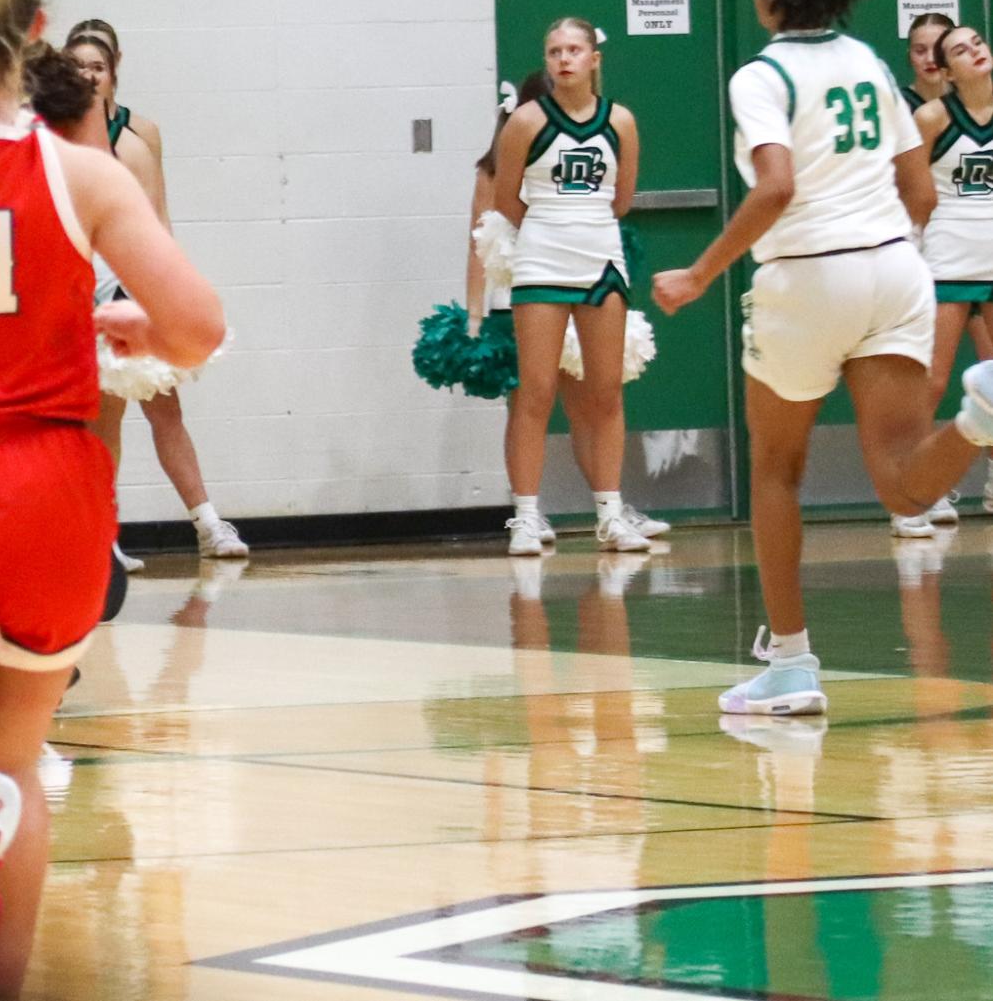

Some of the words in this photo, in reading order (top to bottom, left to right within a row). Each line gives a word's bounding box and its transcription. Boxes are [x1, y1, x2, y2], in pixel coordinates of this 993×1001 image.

[631, 0, 684, 7] Management
[902, 2, 954, 10] Management
[644, 20, 673, 29] ONLY
[825, 81, 881, 154] 33
